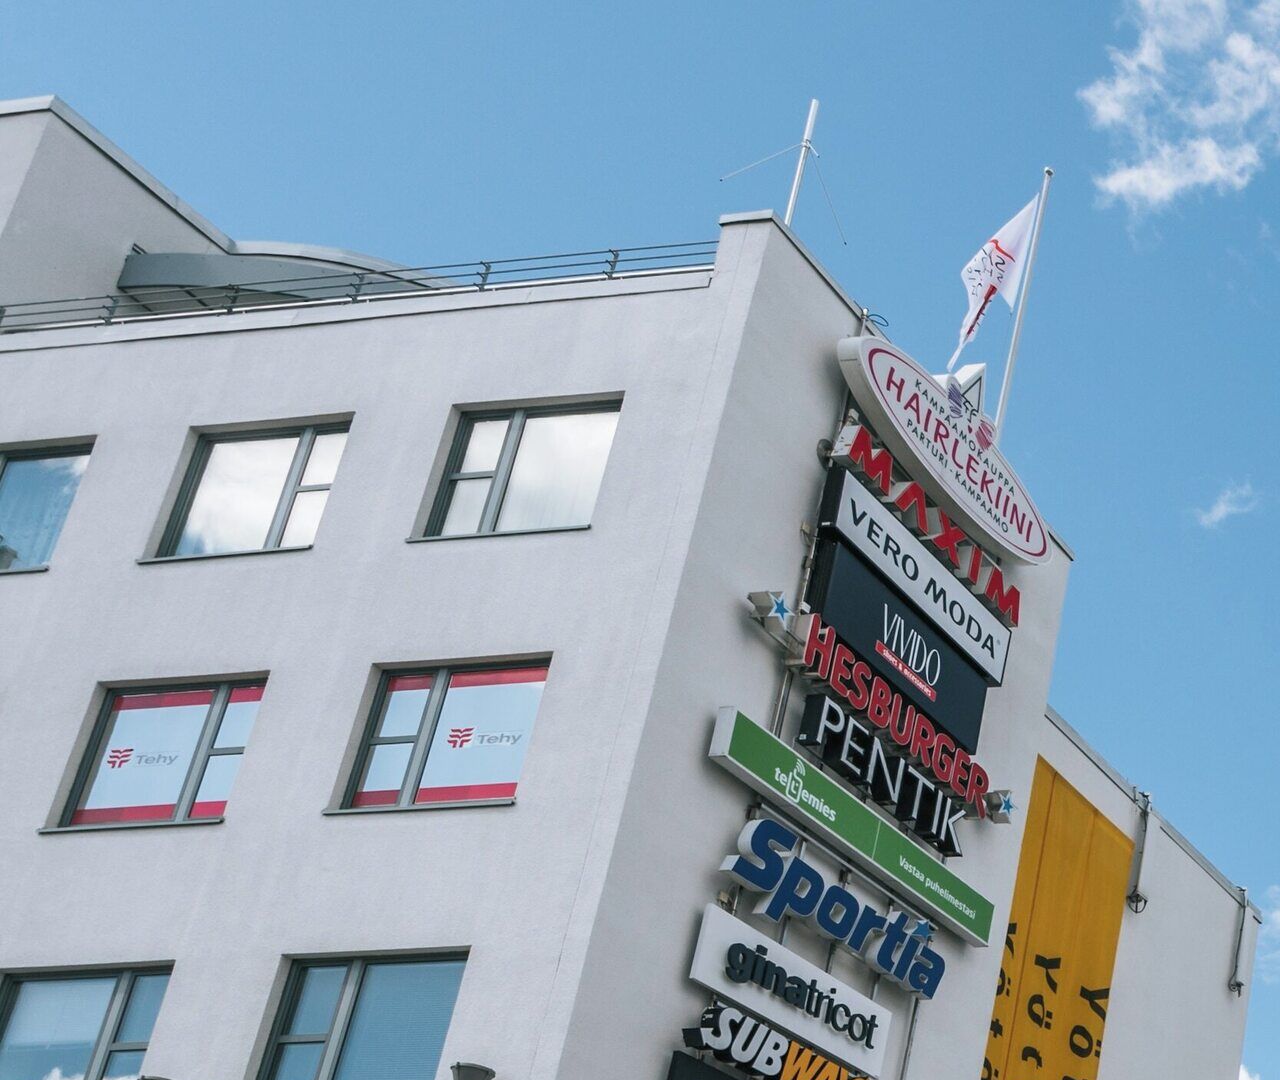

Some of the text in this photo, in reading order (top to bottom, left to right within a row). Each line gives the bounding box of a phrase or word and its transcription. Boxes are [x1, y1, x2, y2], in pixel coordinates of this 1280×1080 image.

[886, 366, 1034, 543] HAIRLEKIINI
[914, 378, 1015, 495] KAMPAAMOKAUPPA
[848, 425, 1020, 627] MAXIM
[850, 497, 996, 660] VERO MODA
[880, 603, 941, 687] VIVIDO
[882, 648, 897, 667] shoes
[903, 664, 934, 699] accessories
[135, 752, 179, 768] Tehy
[476, 731, 523, 747] Tehy
[803, 613, 989, 820] HESBURGER
[816, 696, 968, 857] PENTIK
[728, 818, 946, 1000] Sportia
[899, 855, 976, 920] Vastaa puhelimestasi
[725, 942, 879, 1050] ginatricot
